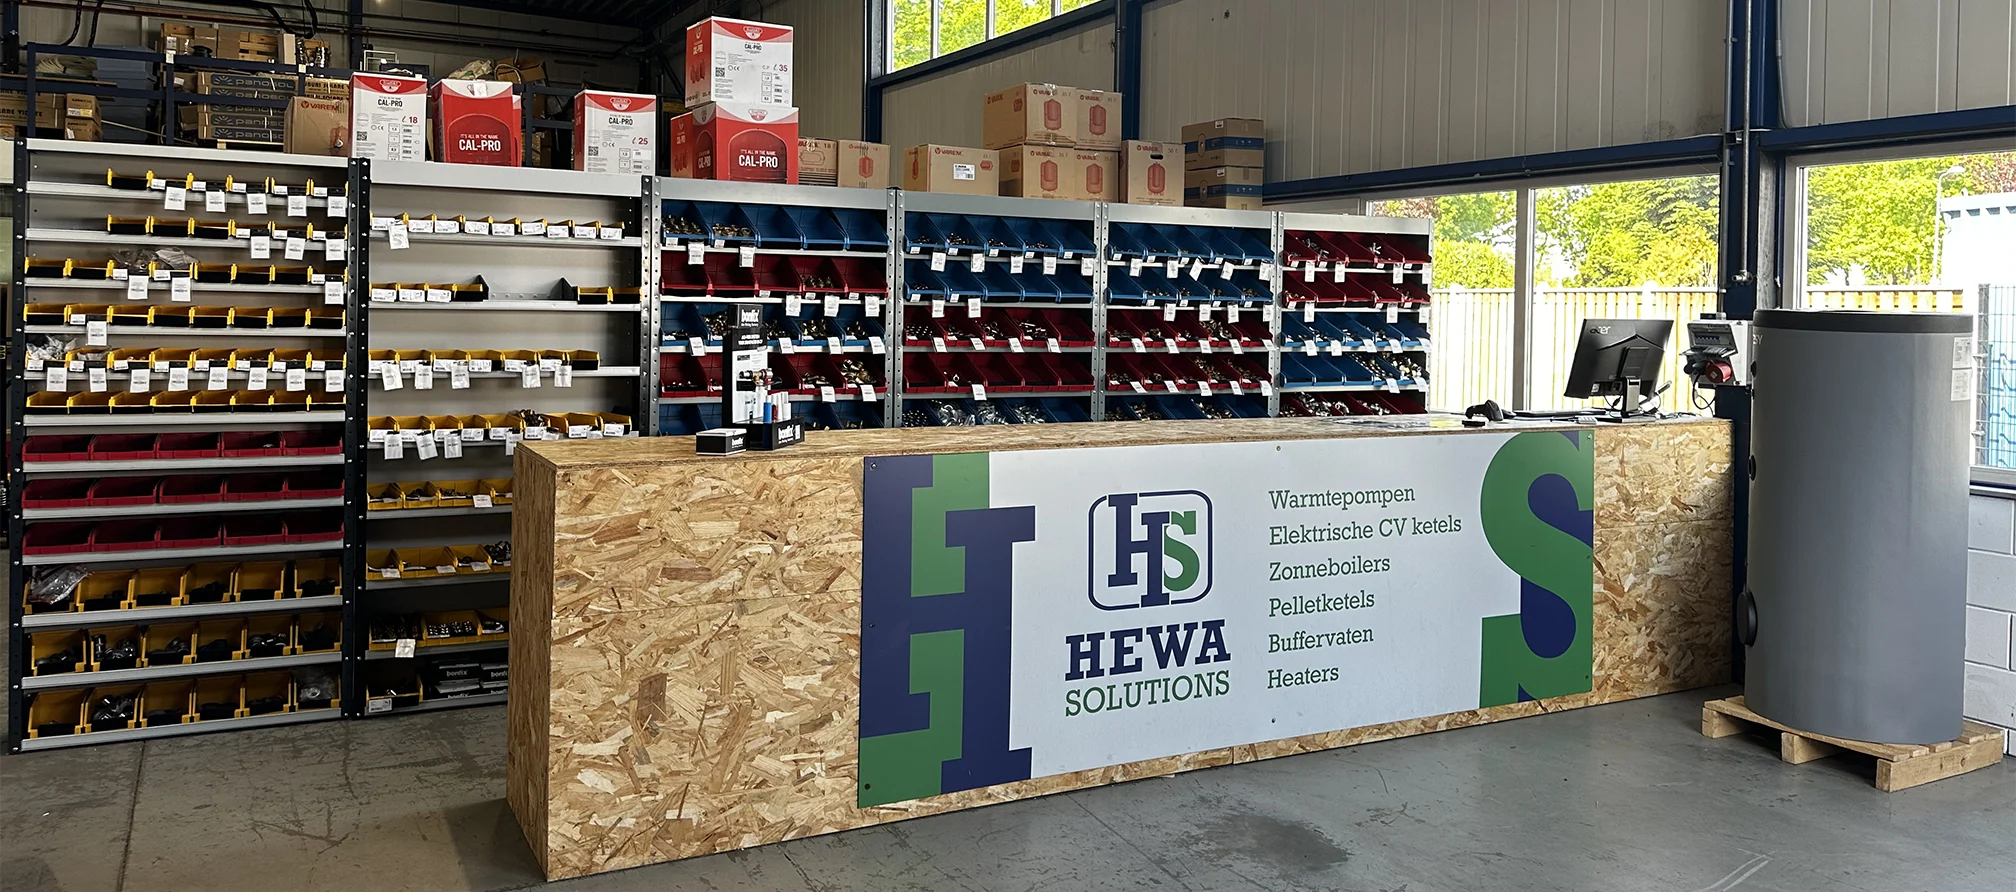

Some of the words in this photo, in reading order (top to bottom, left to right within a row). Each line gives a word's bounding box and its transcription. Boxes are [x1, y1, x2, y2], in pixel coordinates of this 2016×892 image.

[778, 64, 788, 72] 35
[377, 98, 403, 107] CAL-PRO
[235, 116, 284, 127] panoso
[408, 115, 418, 124] 18
[608, 116, 633, 126] CAL-PRO
[235, 129, 284, 139] panoso
[458, 138, 501, 151] CAL-PRO
[638, 137, 648, 146] 25
[738, 154, 778, 168] CAL-PRO
[1269, 487, 1415, 510] Warmtepompen
[1269, 522, 1373, 545] Elektrische
[1379, 518, 1407, 537] CV
[1411, 515, 1462, 535] ketels
[1269, 555, 1390, 581] Zonneboilers
[1269, 590, 1375, 617] Pelletketels
[1268, 628, 1374, 653] Buffervaten
[1065, 619, 1231, 681] HEWA
[1267, 667, 1339, 689] Heaters
[1065, 670, 1230, 716] SOLUTIONS
